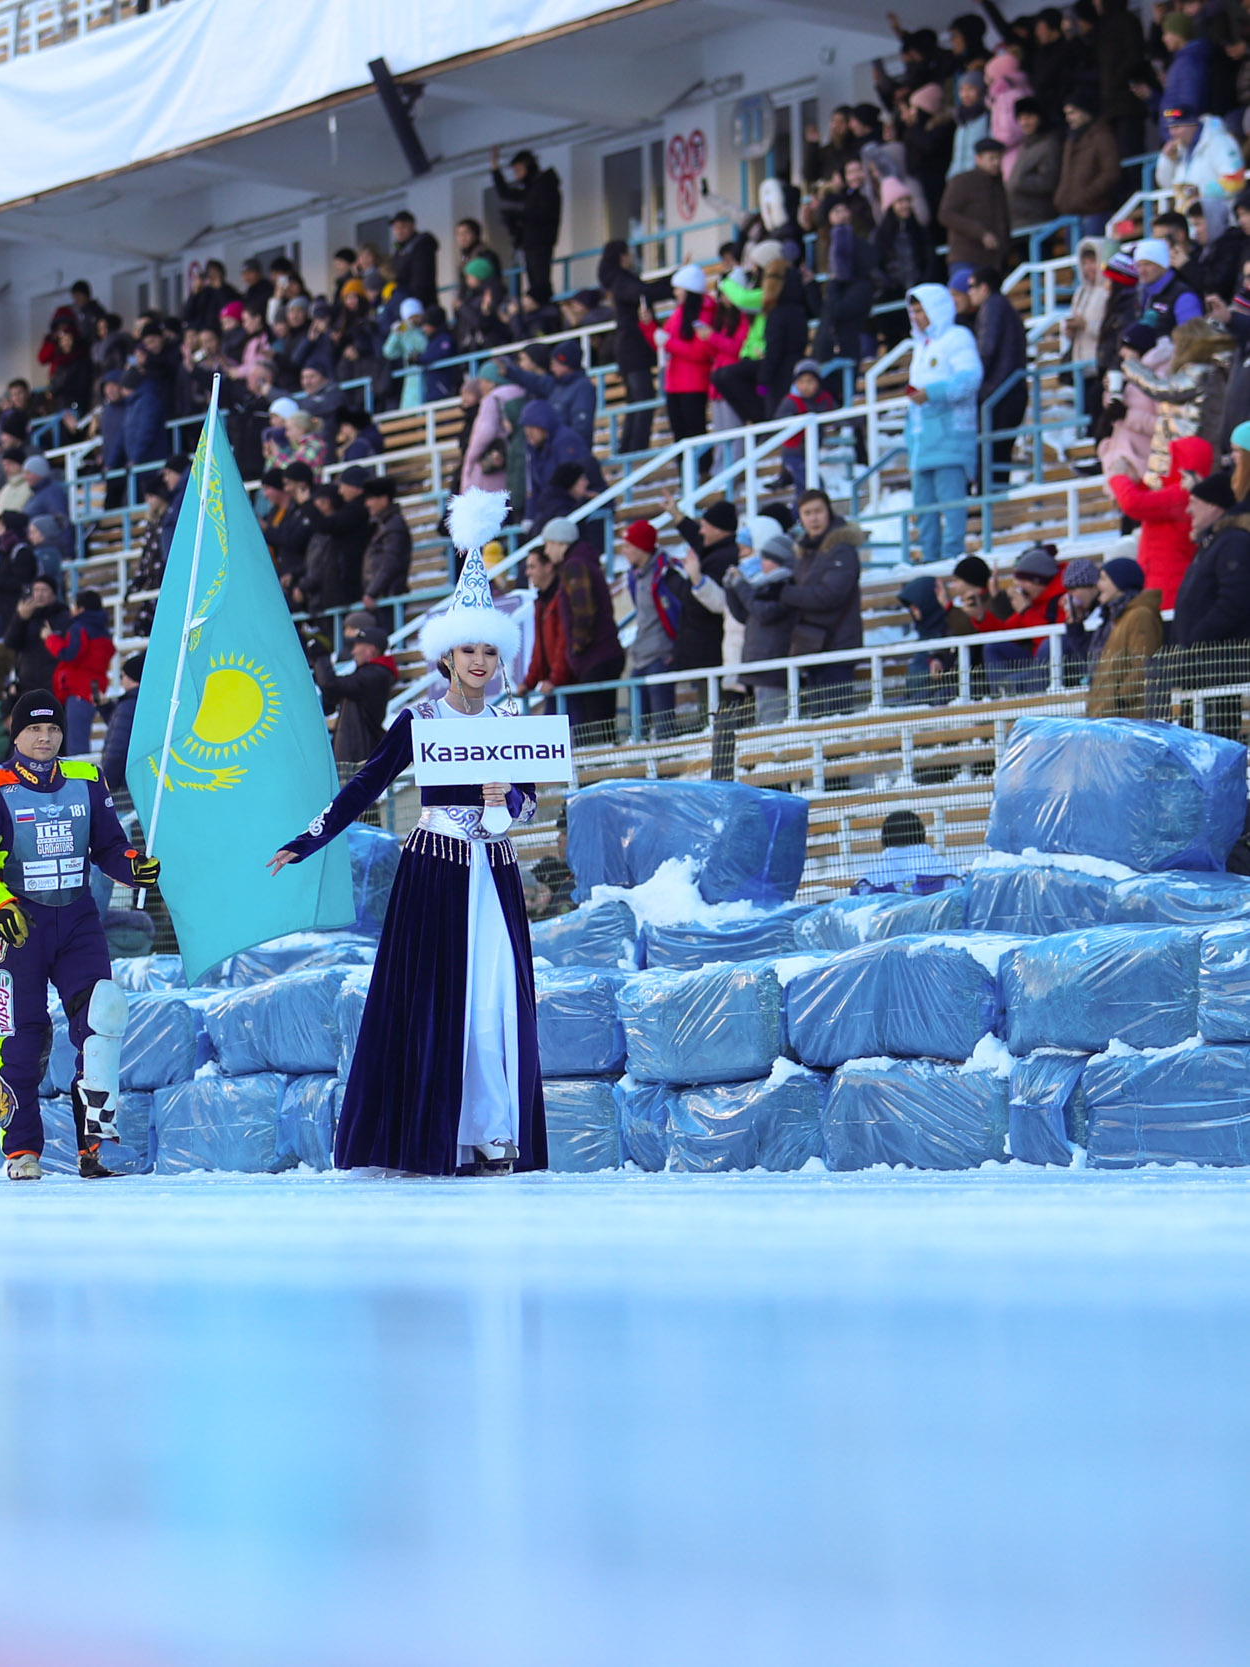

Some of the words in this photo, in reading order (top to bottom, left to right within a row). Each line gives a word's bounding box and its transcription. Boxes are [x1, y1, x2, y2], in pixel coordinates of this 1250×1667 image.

[420, 742, 565, 763] Казахстан
[15, 761, 38, 785] WACO
[69, 804, 86, 817] 181
[36, 823, 72, 838] ICE
